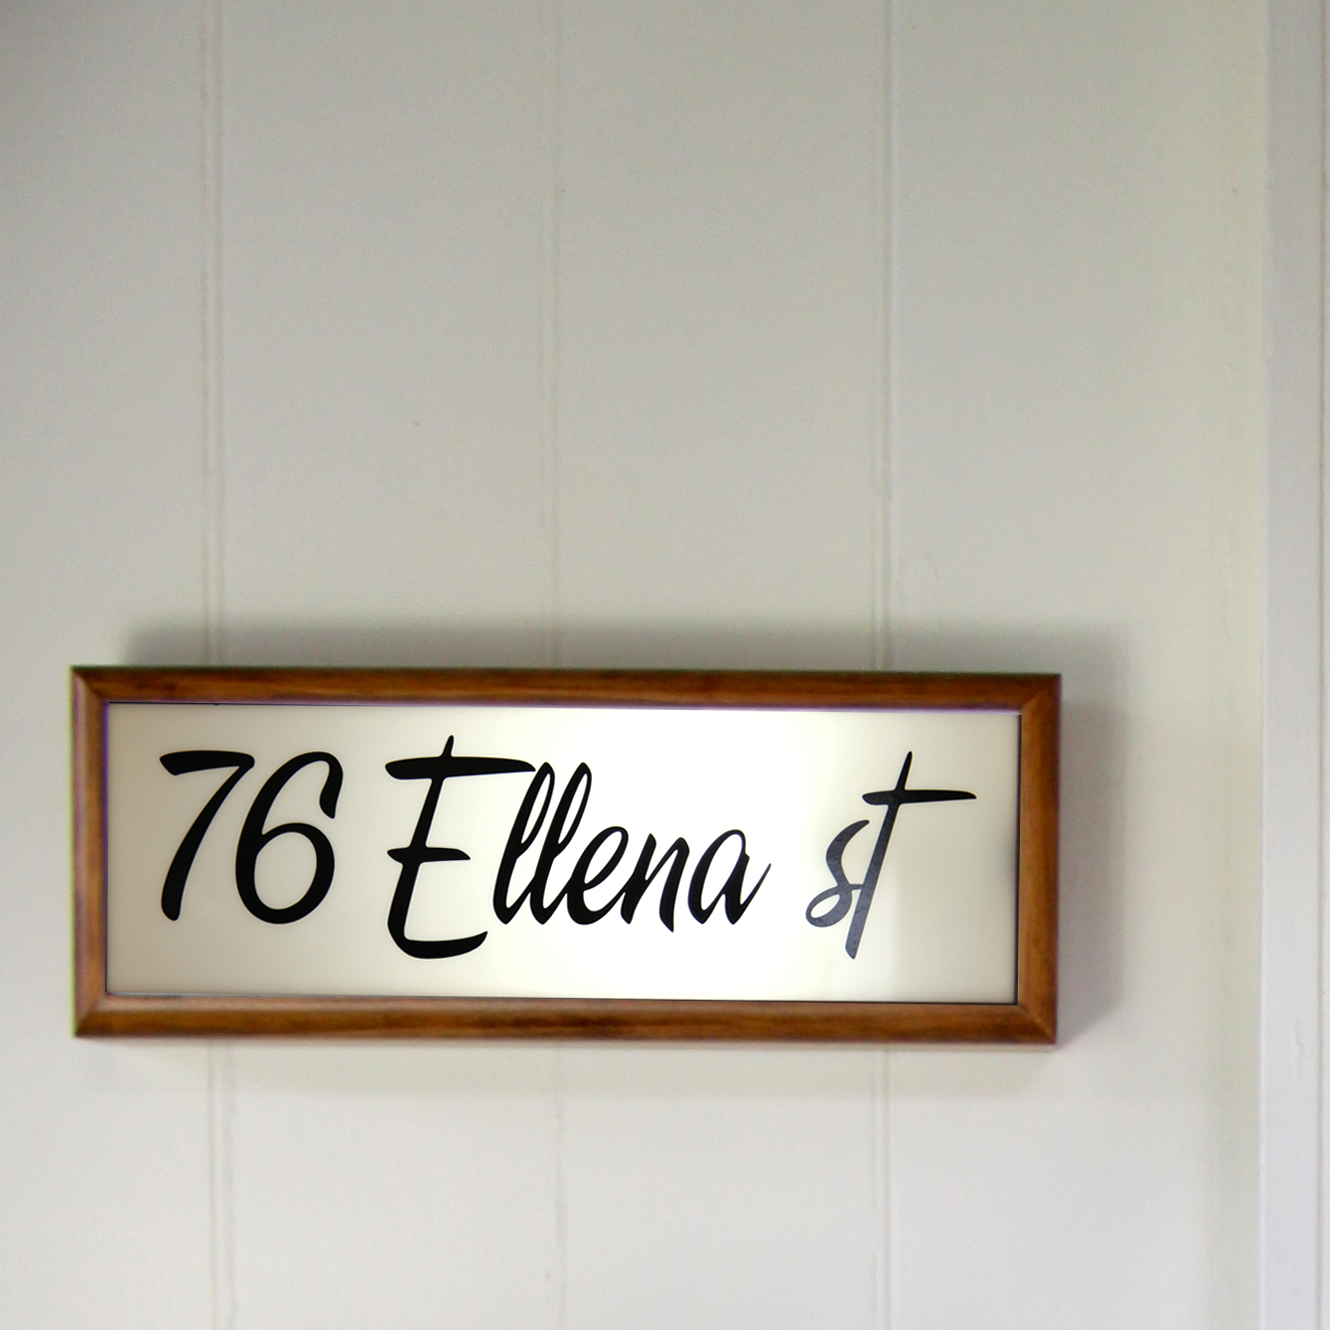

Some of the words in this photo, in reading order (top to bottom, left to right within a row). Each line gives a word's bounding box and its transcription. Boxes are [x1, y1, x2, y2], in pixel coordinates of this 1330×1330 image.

[159, 750, 343, 924] 76
[385, 735, 771, 959] Ellena
[805, 751, 977, 959] st
